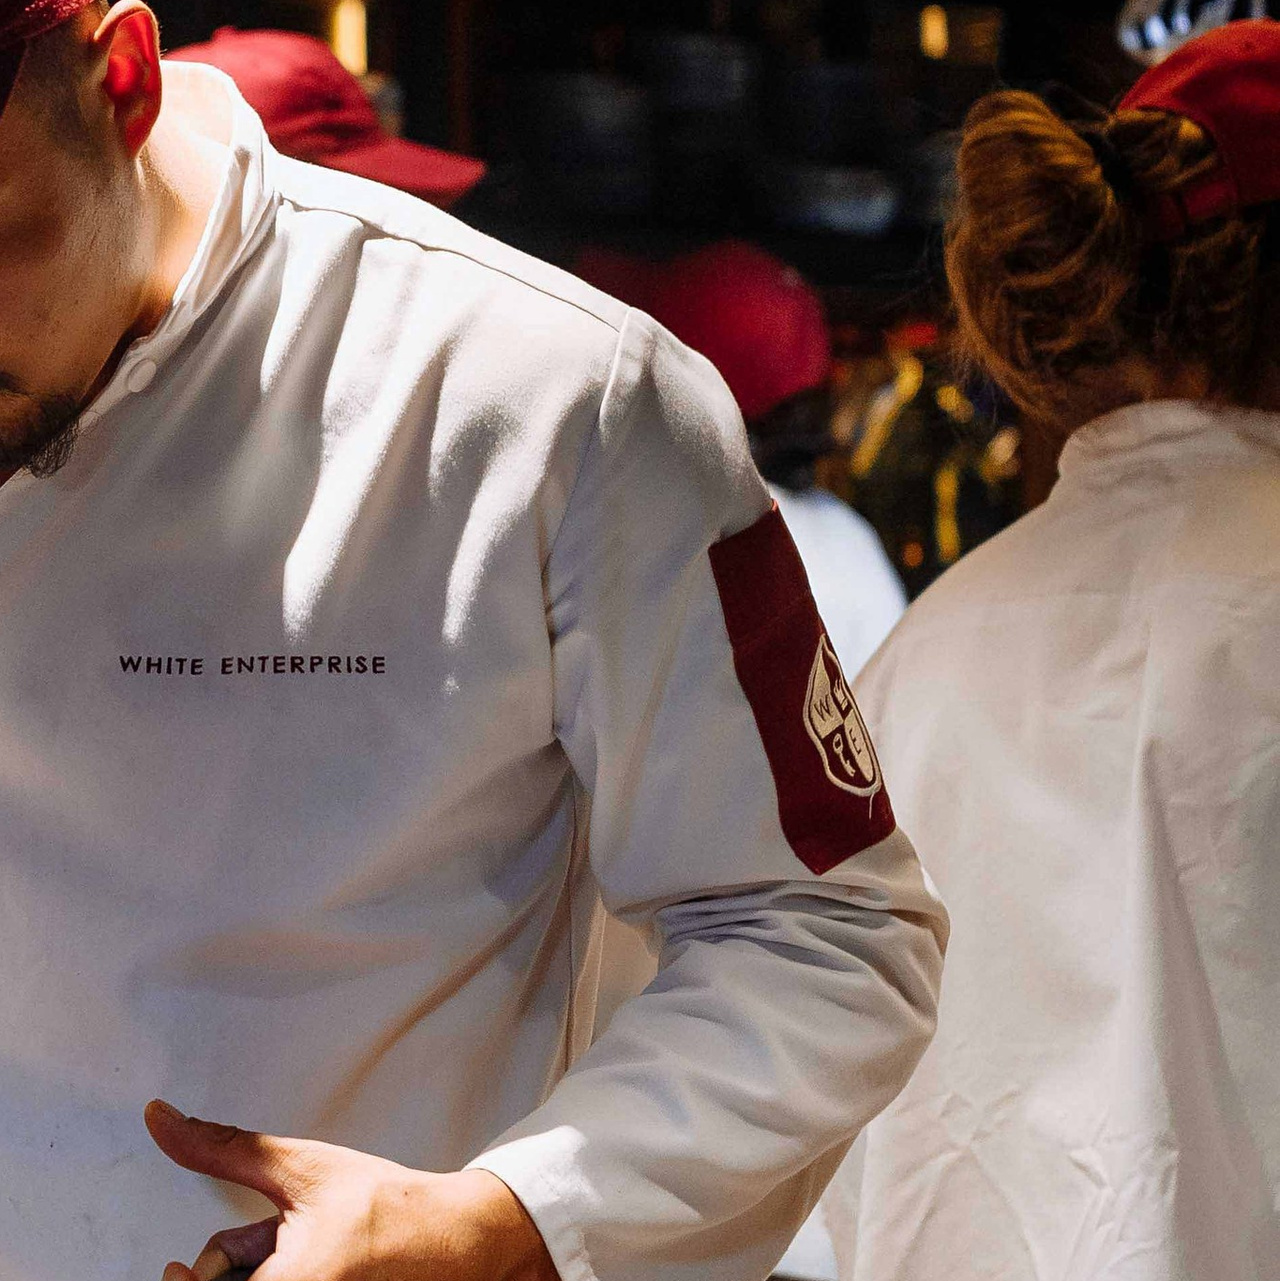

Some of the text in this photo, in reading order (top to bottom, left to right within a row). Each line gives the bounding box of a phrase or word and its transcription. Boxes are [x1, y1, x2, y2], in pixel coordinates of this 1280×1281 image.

[119, 655, 386, 675] WHITE ENTERPRISE
[814, 694, 830, 722] W
